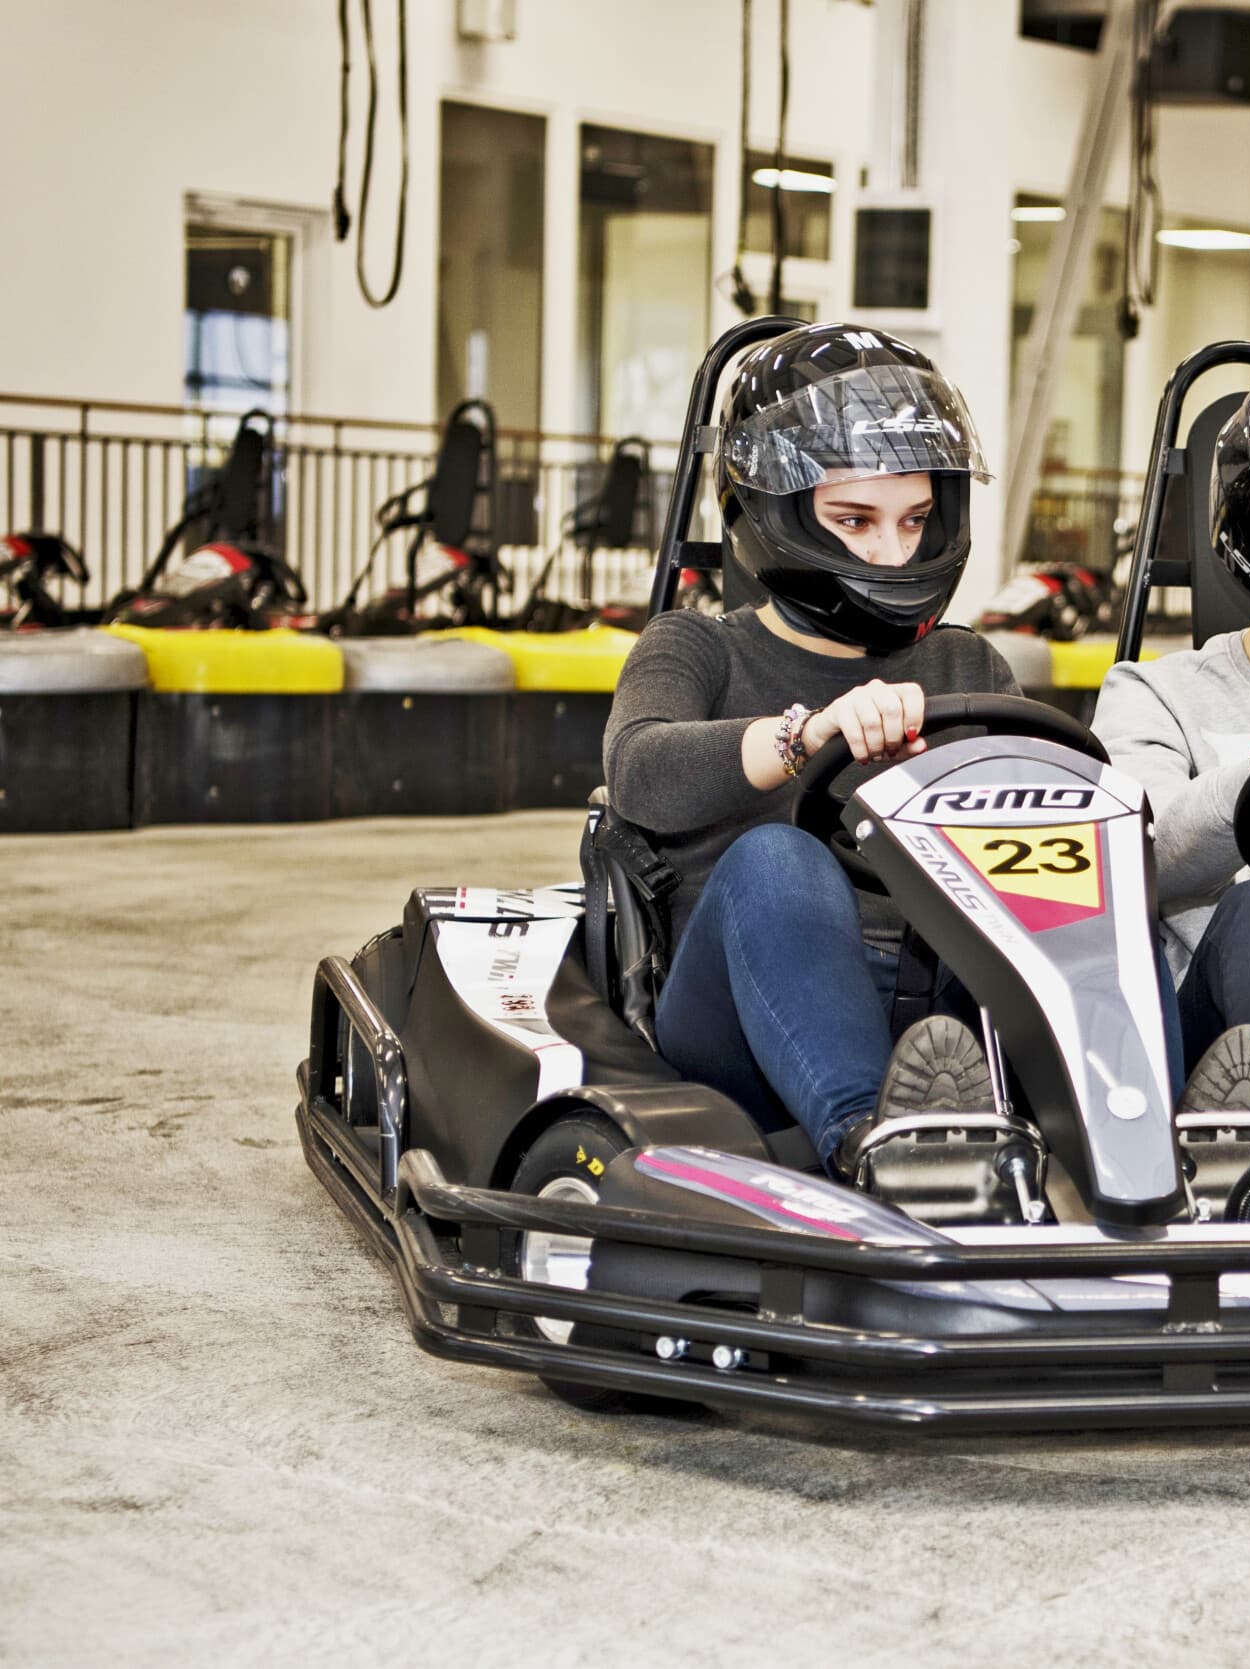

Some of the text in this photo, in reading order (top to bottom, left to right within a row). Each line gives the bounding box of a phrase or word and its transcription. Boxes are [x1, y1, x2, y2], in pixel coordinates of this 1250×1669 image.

[842, 331, 884, 350] M
[851, 417, 942, 434] LS2
[983, 838, 1091, 875] 23
